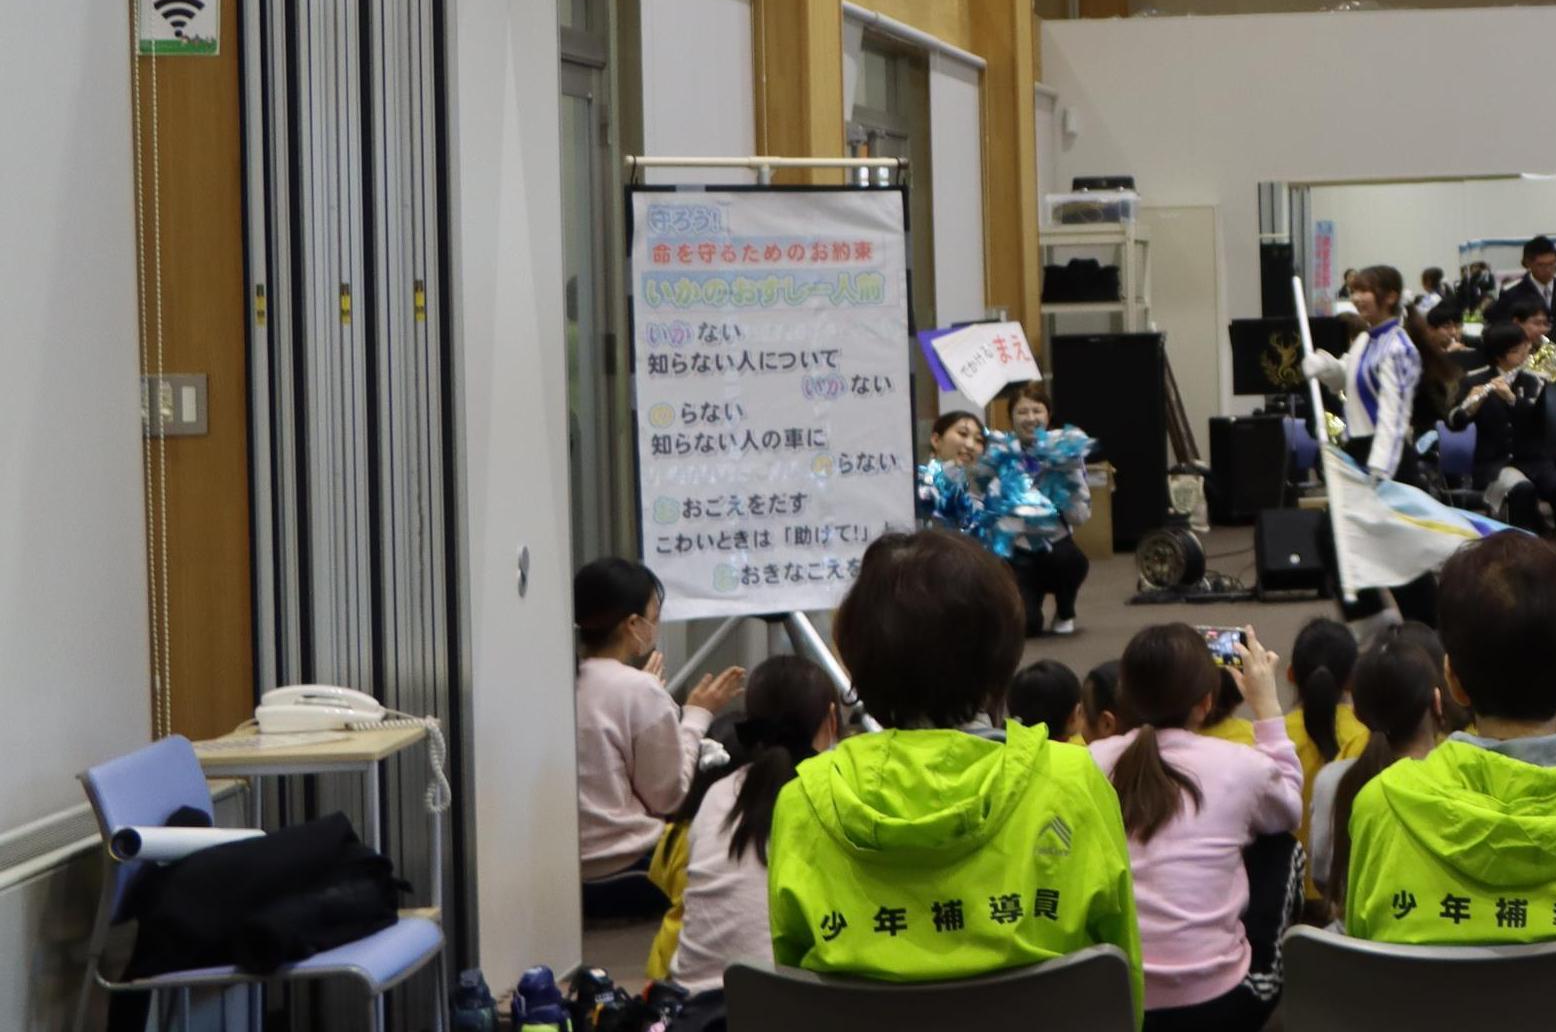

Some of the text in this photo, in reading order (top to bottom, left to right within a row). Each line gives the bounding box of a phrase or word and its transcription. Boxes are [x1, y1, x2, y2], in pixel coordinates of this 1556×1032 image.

[651, 239, 874, 265] 命を守るためのお約束
[648, 348, 840, 375] 知らない人について
[651, 427, 826, 456] 知らない人の車に
[820, 888, 1060, 942] 少年補導員
